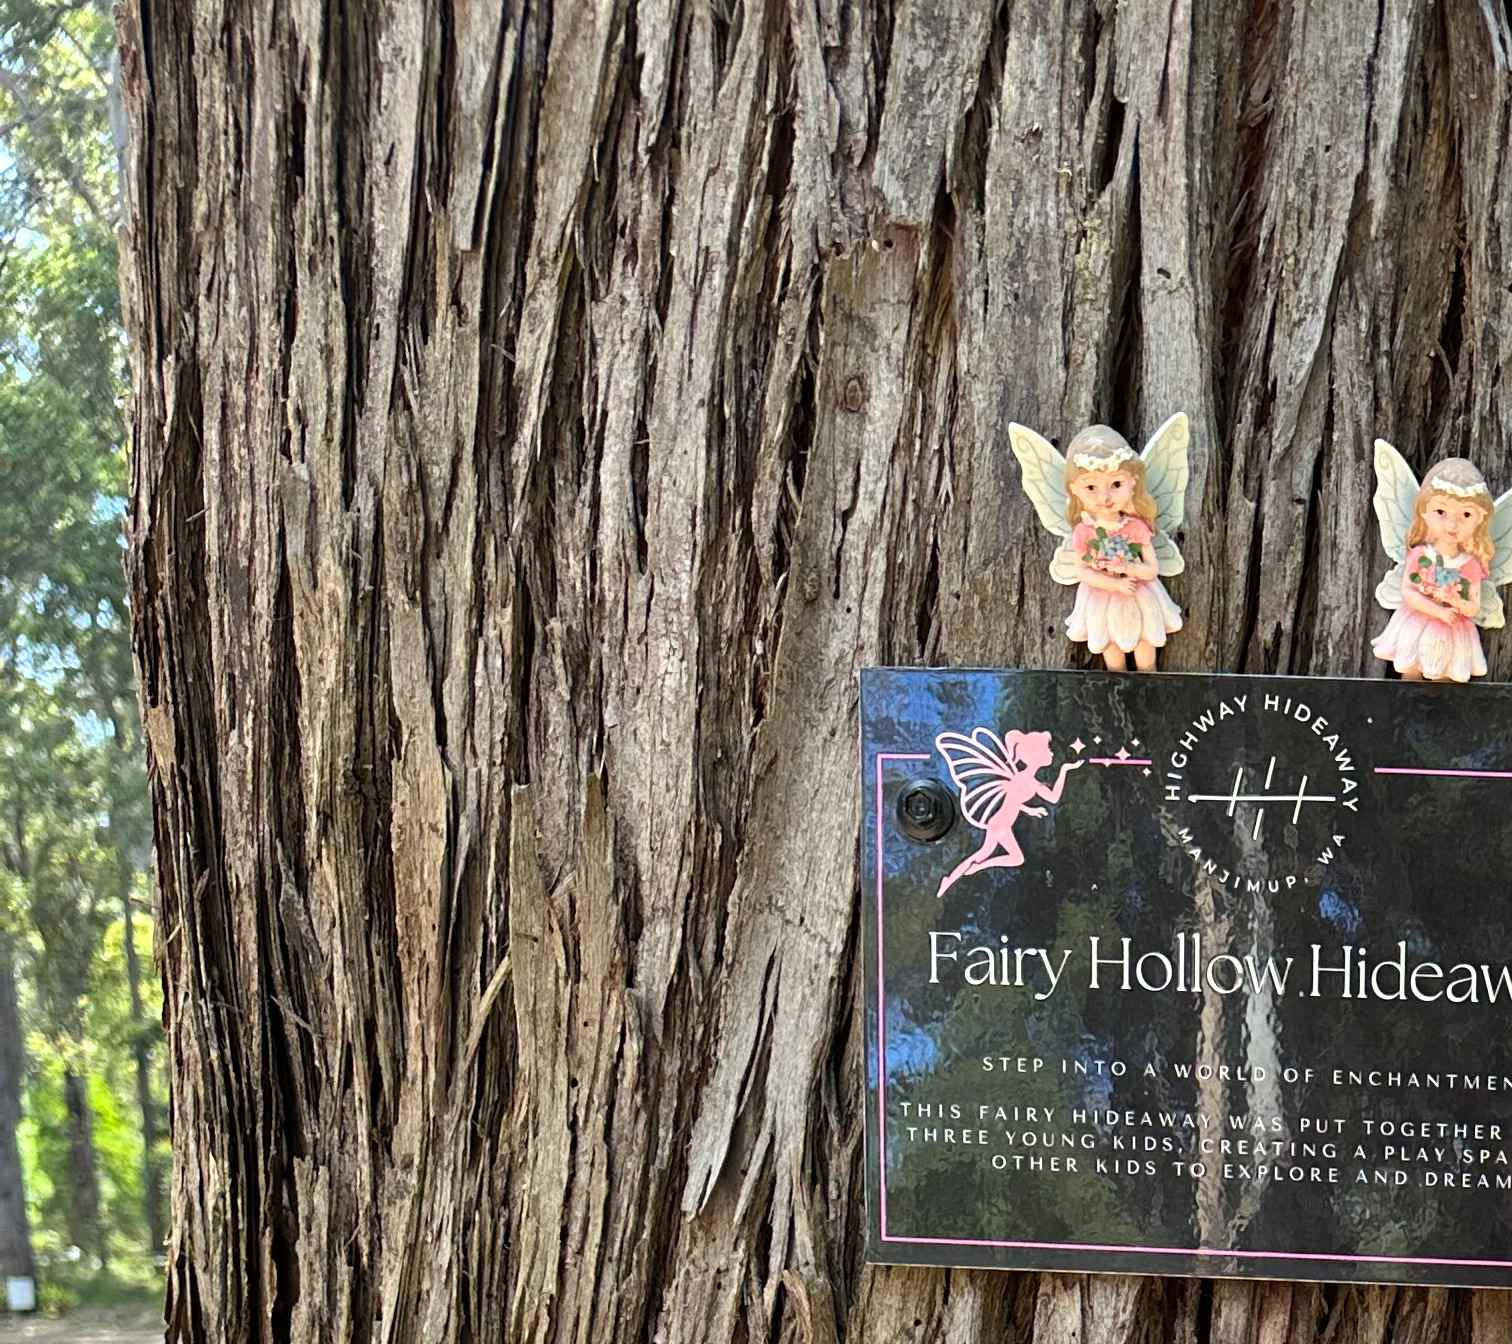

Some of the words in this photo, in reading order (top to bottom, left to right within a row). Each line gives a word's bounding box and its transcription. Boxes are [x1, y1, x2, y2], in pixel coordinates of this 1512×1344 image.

[1165, 694, 1247, 800] HIGHWAY
[1264, 694, 1359, 812] HIDEAWAY
[1178, 827, 1309, 893] MANJIMUP,
[1317, 834, 1345, 865] WA
[928, 931, 1072, 1000] Fairy
[1089, 932, 1294, 995] Hollow
[982, 1056, 1044, 1073] STEP
[1061, 1059, 1127, 1076] INTO
[1144, 1063, 1156, 1076] A
[1174, 1063, 1266, 1082] WORLD
[1283, 1068, 1316, 1084] OF
[900, 1102, 961, 1119] THIS
[979, 1105, 1055, 1123] FAIRY
[1073, 1109, 1211, 1129] HIDEAWAY
[1229, 1115, 1283, 1132] WAS
[1300, 1118, 1347, 1134] PUT
[1363, 1120, 1502, 1140] TOGETHER
[906, 1127, 989, 1145] THREE
[1005, 1131, 1095, 1149] YOUNG
[1113, 1135, 1184, 1154] KIDS,
[1201, 1139, 1337, 1159] CREATING
[1354, 1146, 1368, 1160] A
[1384, 1145, 1446, 1163] PLAY
[992, 1154, 1077, 1172] OTHER
[1096, 1158, 1156, 1175] KIDS
[1174, 1162, 1206, 1178] TO
[1223, 1164, 1340, 1184] EXPLORE
[1355, 1172, 1408, 1185] AND
